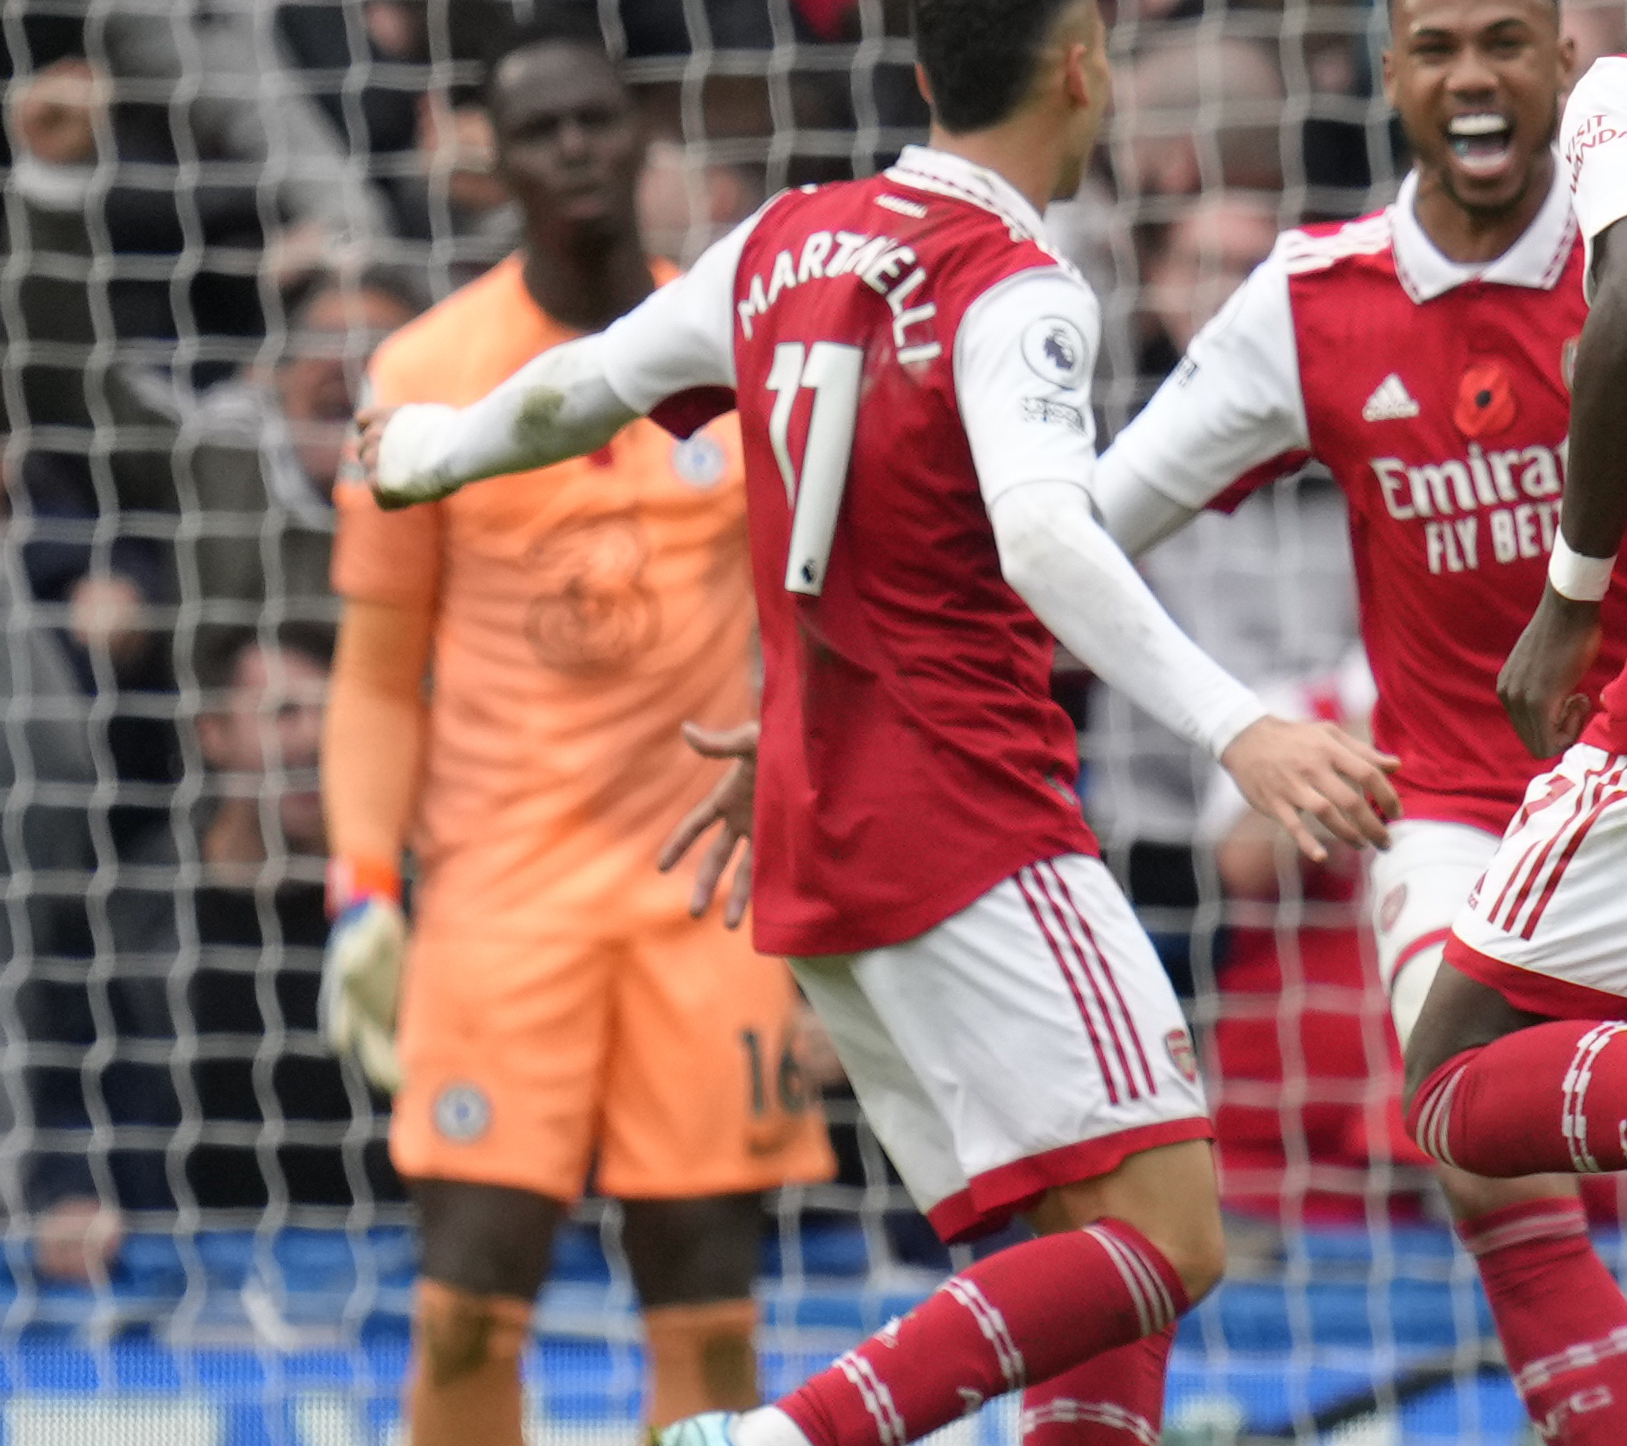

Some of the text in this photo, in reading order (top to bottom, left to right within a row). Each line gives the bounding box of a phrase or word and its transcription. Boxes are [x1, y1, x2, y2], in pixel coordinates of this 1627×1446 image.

[764, 340, 864, 595] 11
[1369, 441, 1569, 521] Emira
[1424, 498, 1562, 575] FLY BET
